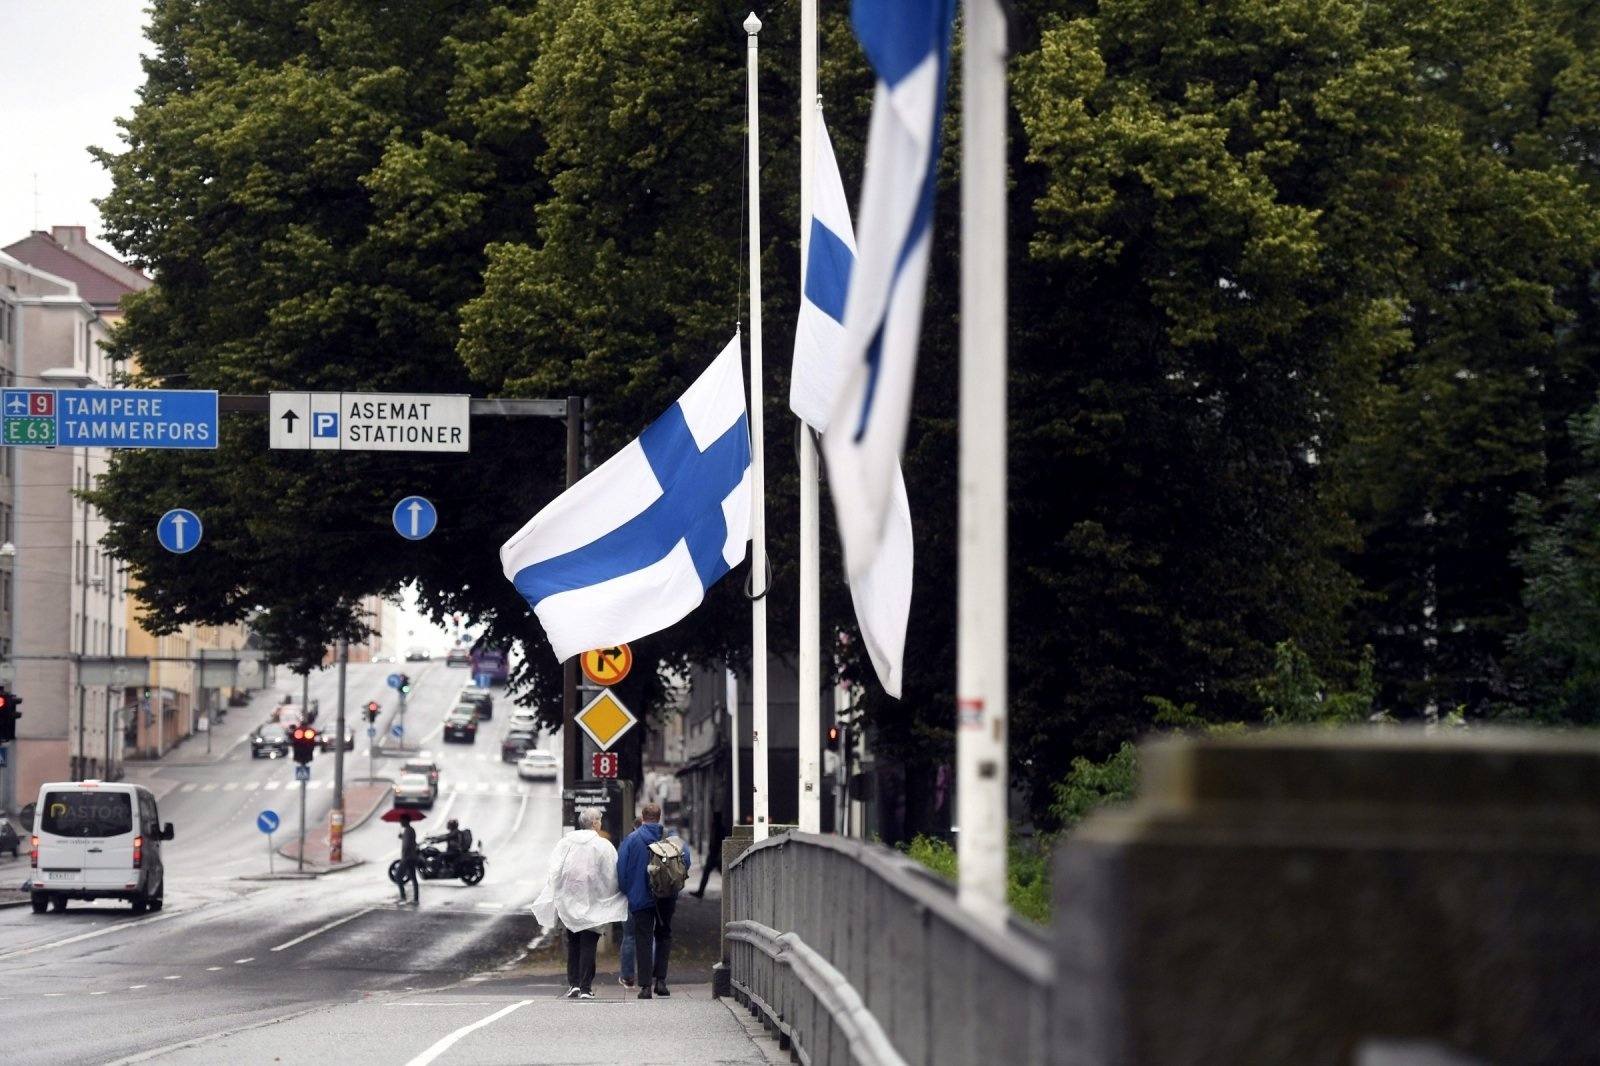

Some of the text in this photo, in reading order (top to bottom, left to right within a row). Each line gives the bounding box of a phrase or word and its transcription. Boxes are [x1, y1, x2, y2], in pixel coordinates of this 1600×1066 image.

[36, 396, 47, 413] 9
[65, 397, 163, 416] TAMPERE
[349, 402, 431, 421] ASEMAT
[9, 422, 50, 440] E 63
[65, 421, 209, 440] TAMMERFORS
[317, 414, 334, 436] P
[349, 425, 462, 444] STATIONER
[599, 756, 610, 774] 8
[50, 803, 124, 820] PASTOR
